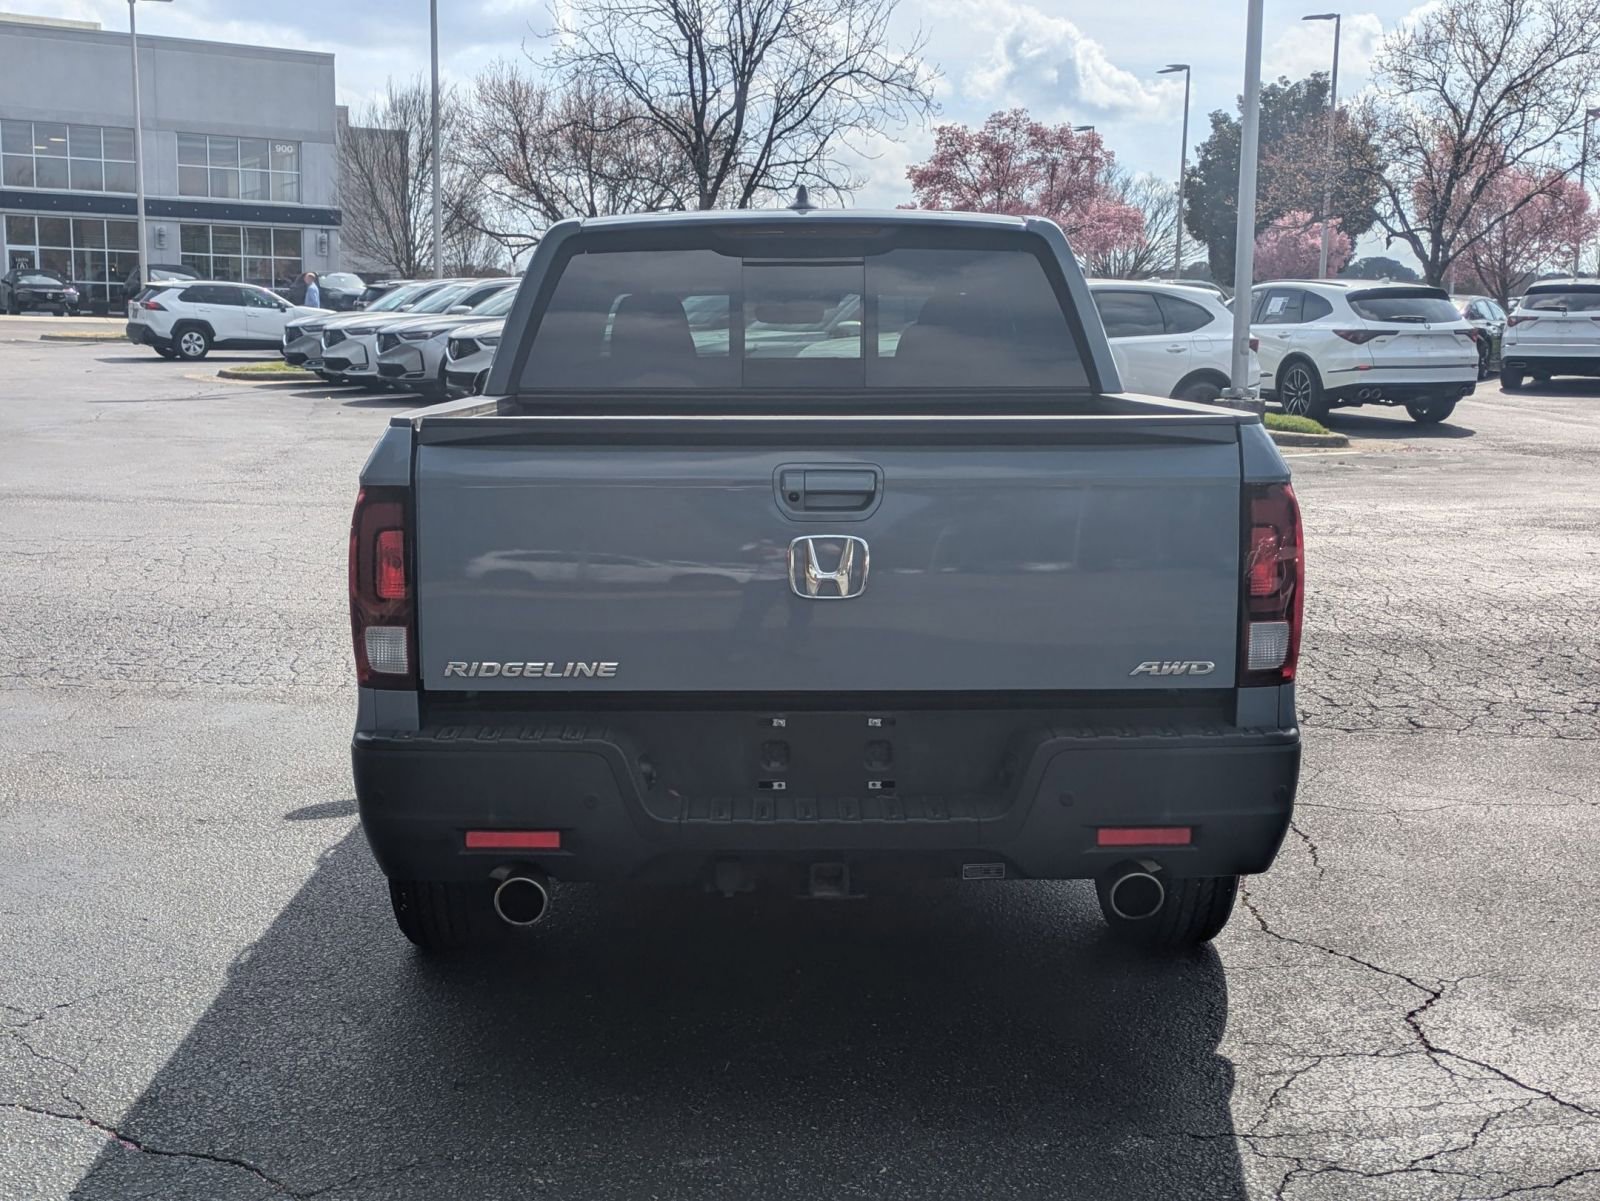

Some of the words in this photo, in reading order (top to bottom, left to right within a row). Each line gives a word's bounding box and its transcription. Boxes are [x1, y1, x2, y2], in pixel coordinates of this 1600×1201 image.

[275, 145, 293, 153] 900
[444, 661, 619, 677] RIDGELINE
[1129, 661, 1215, 675] AWD
